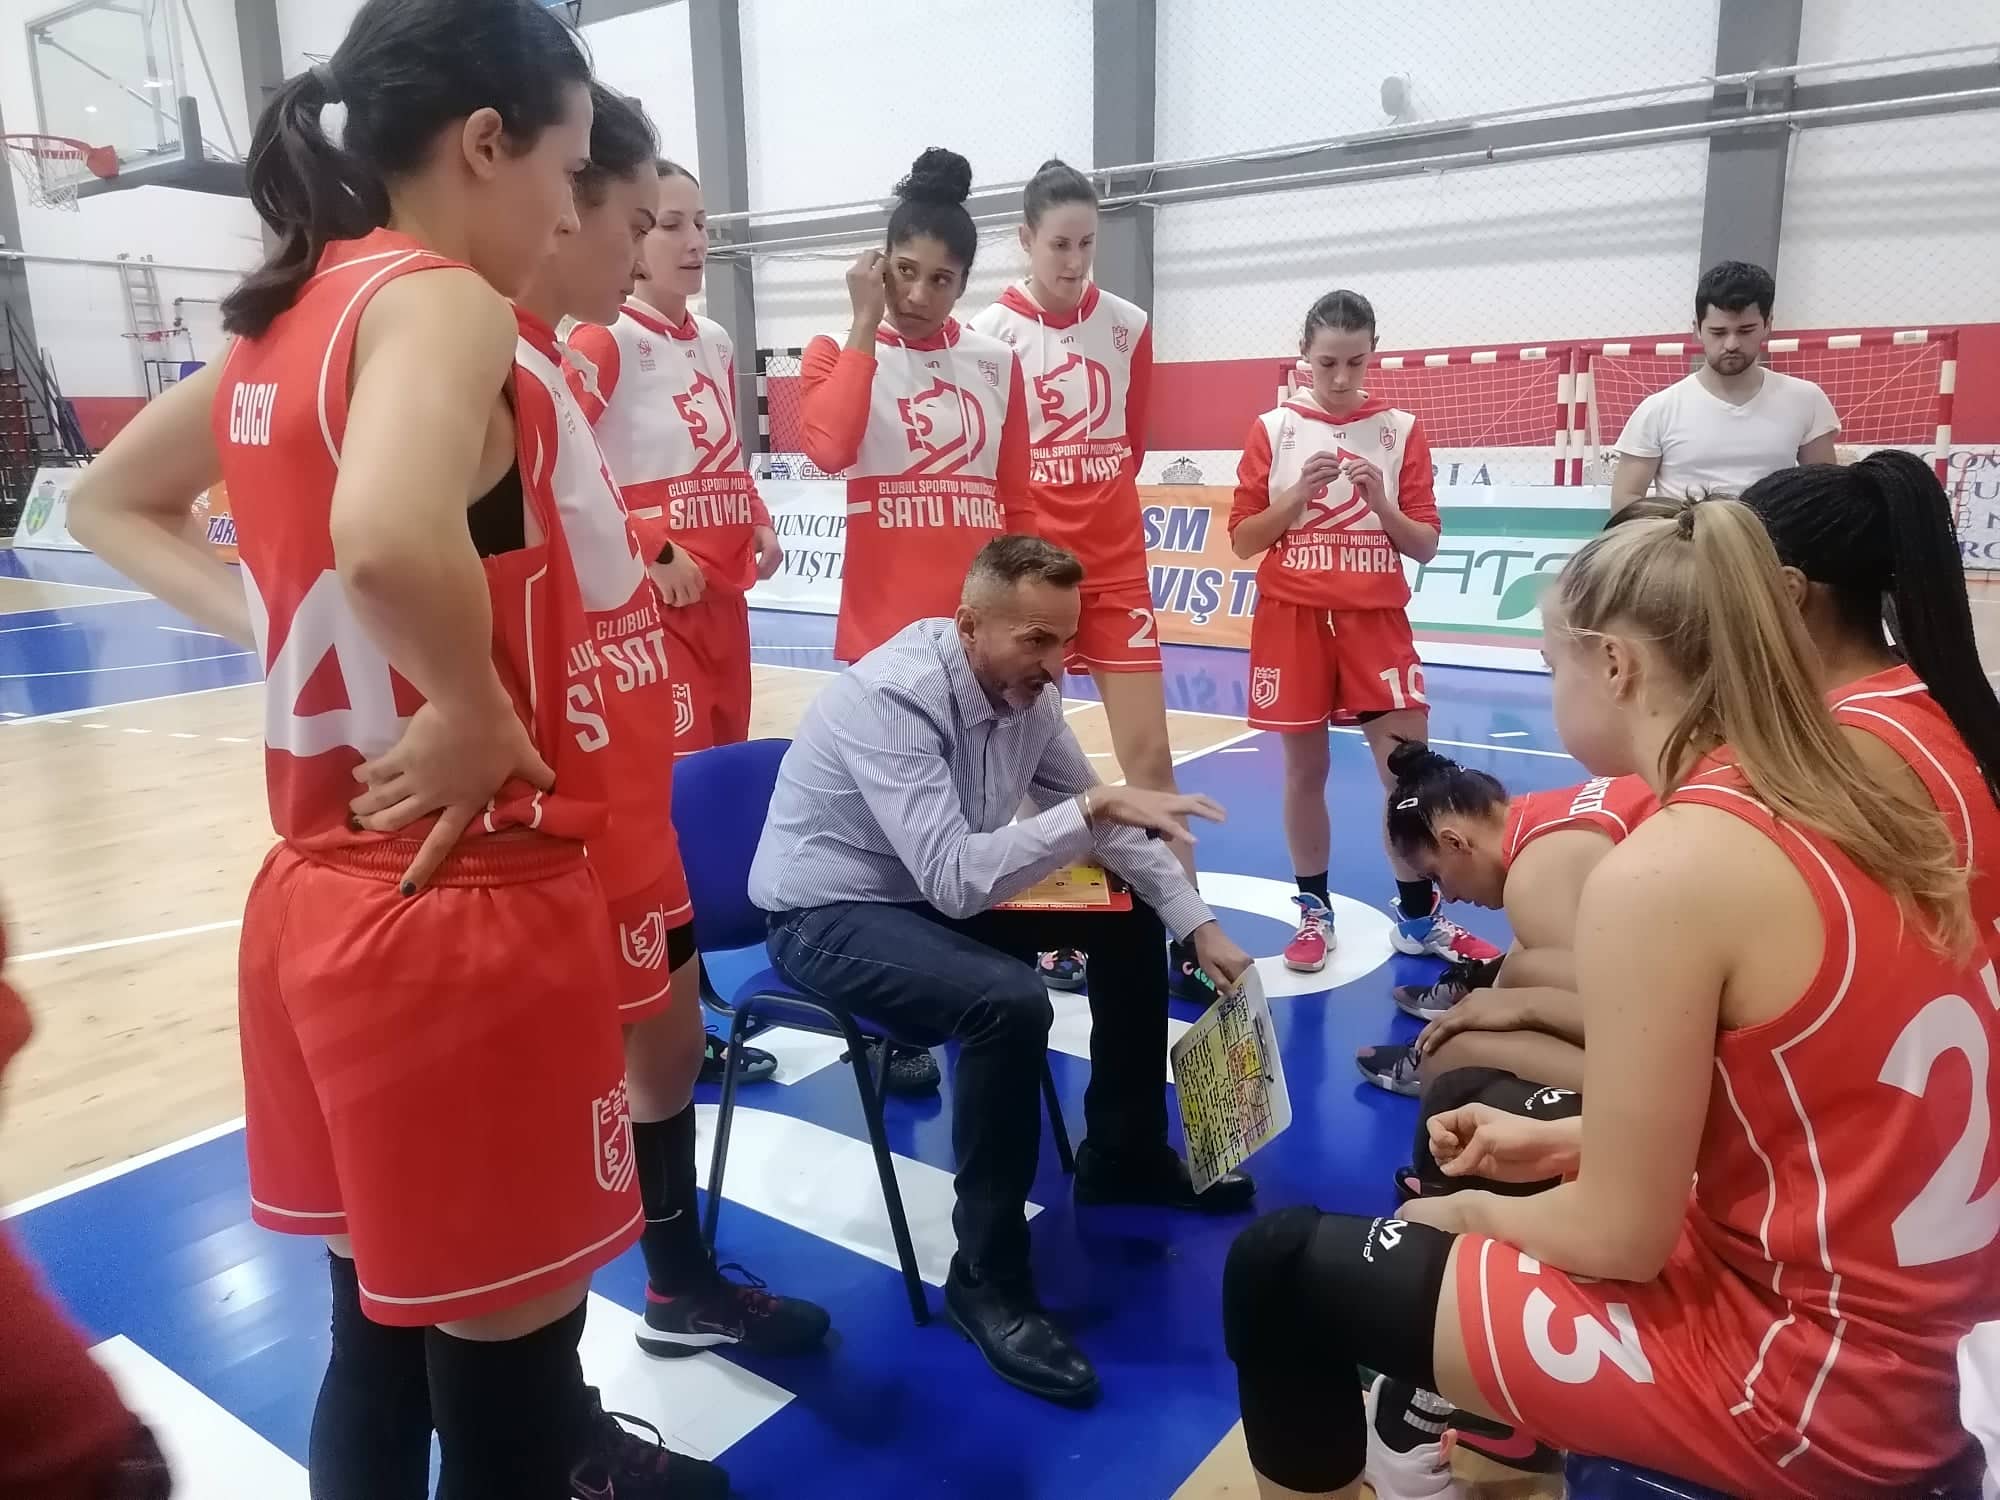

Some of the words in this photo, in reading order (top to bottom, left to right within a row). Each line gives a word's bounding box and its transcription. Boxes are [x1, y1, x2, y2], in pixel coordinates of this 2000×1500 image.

[229, 382, 278, 446] CUCU
[878, 495, 945, 529] SATU
[1281, 544, 1333, 571] SATU
[1340, 546, 1397, 573] MARE
[596, 607, 653, 640] CLUBUL
[600, 627, 669, 692] SAT
[566, 673, 610, 753] S
